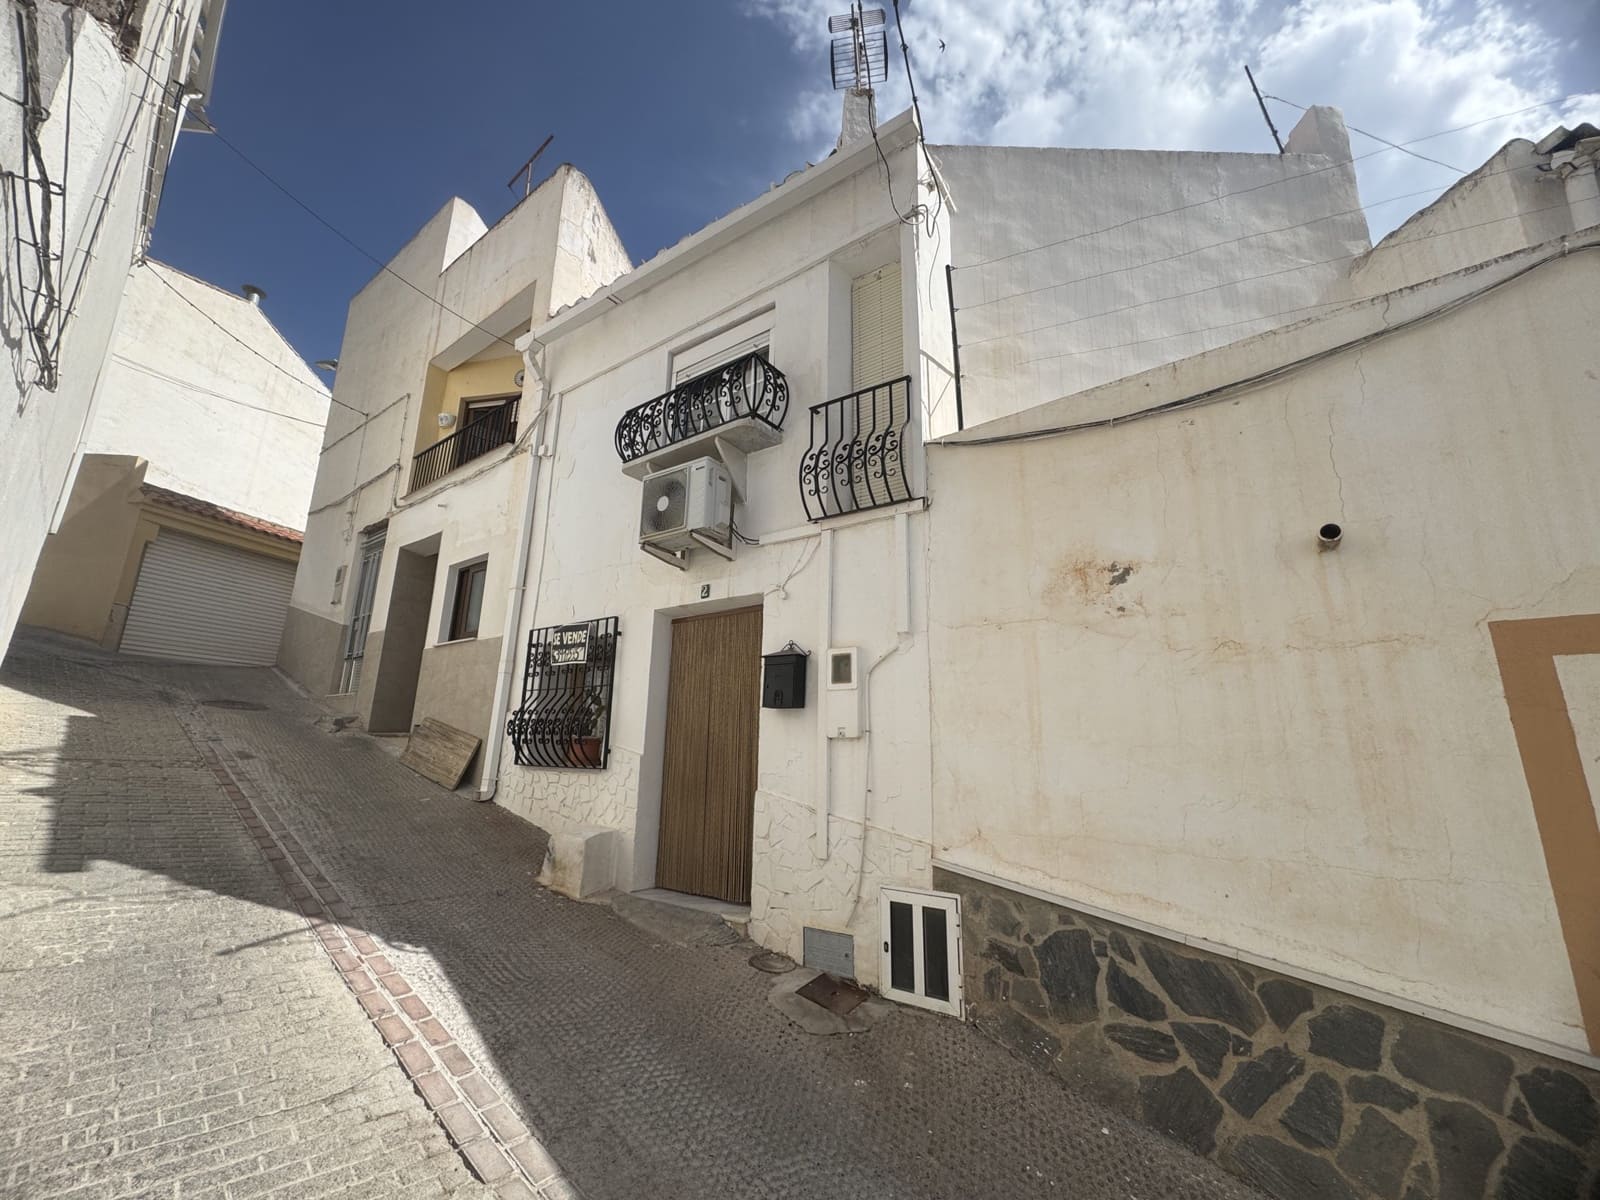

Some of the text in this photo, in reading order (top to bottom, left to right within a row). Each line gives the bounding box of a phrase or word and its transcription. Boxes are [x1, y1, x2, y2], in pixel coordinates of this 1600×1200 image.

[701, 585, 709, 598] 2
[553, 630, 587, 645] SE VENDE
